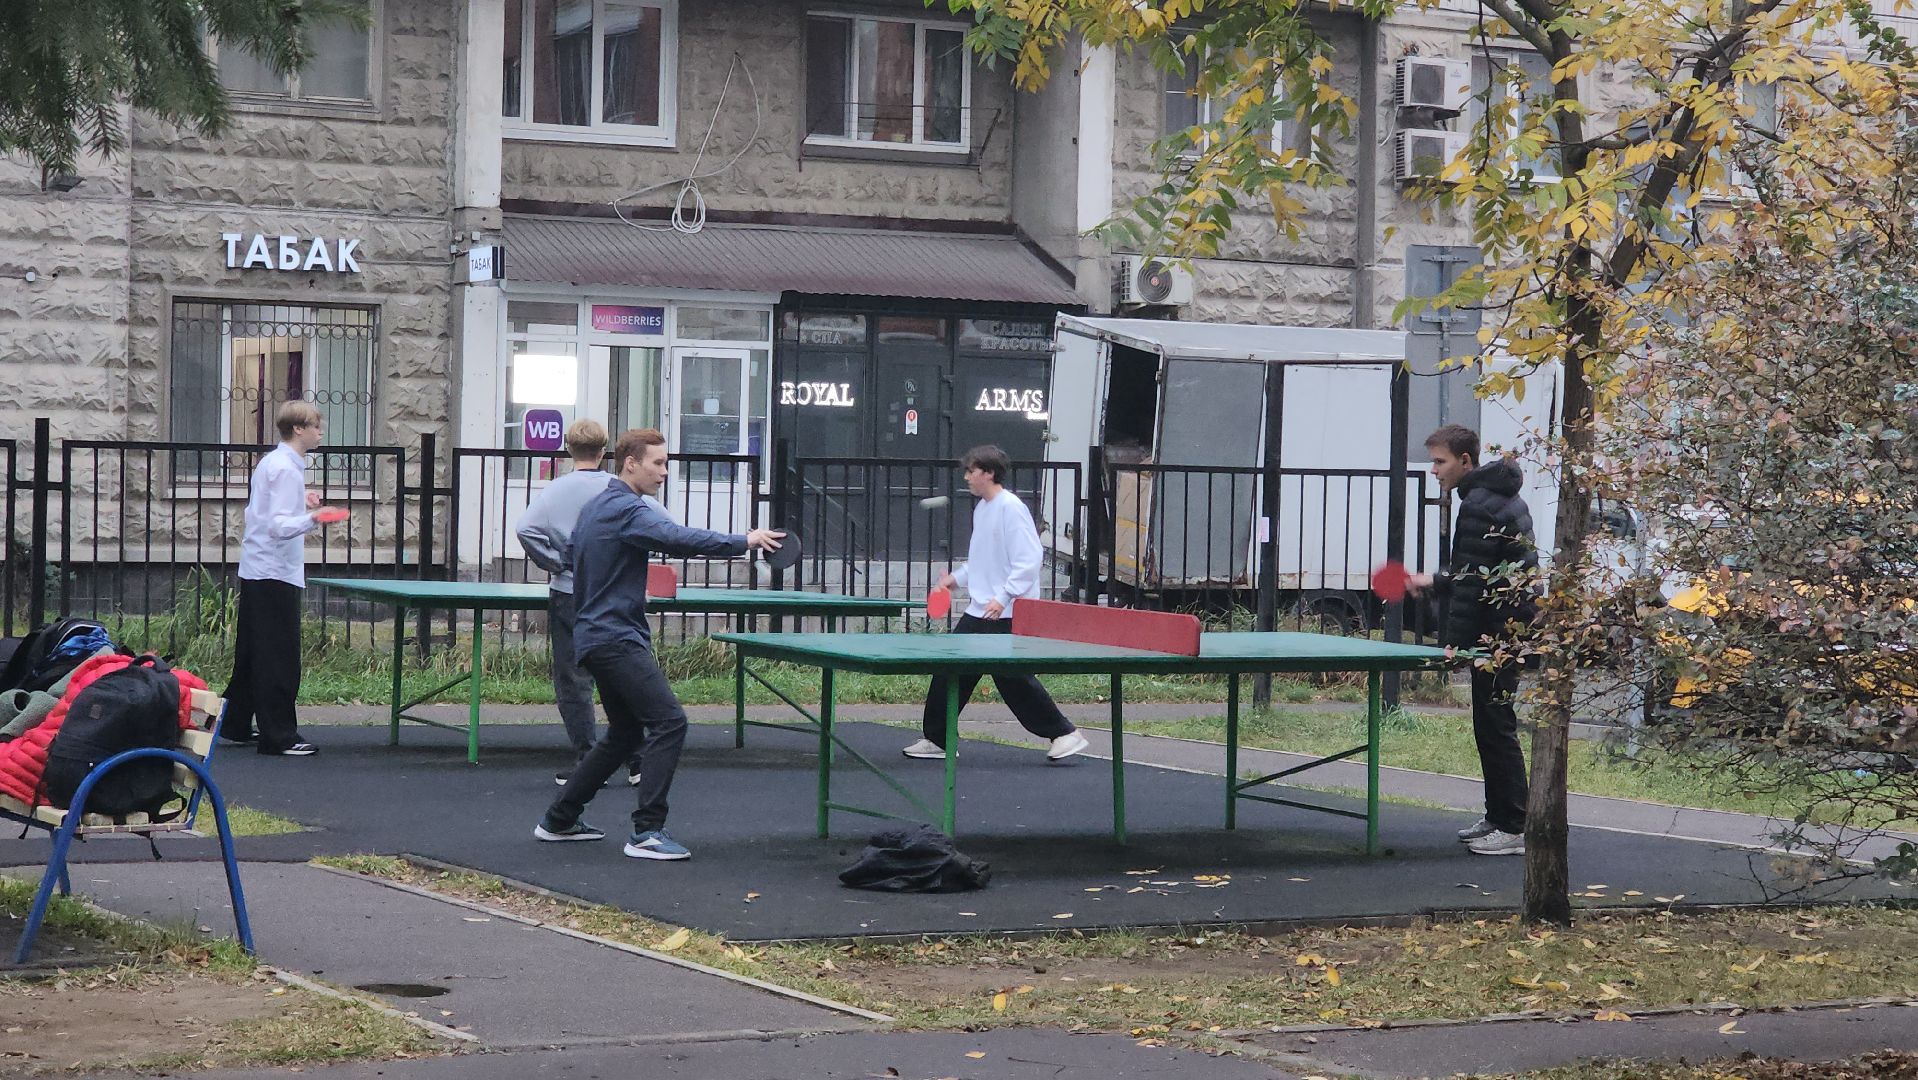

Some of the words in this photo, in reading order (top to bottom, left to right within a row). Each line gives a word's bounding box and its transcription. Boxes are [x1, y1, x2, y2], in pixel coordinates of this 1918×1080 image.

[222, 232, 362, 273] ТАБАК
[471, 257, 491, 270] ТАБАК
[595, 313, 661, 328] WILDBERRIES
[780, 382, 854, 407] ROYAL
[975, 387, 1043, 412] ARMS
[527, 420, 561, 439] WB
